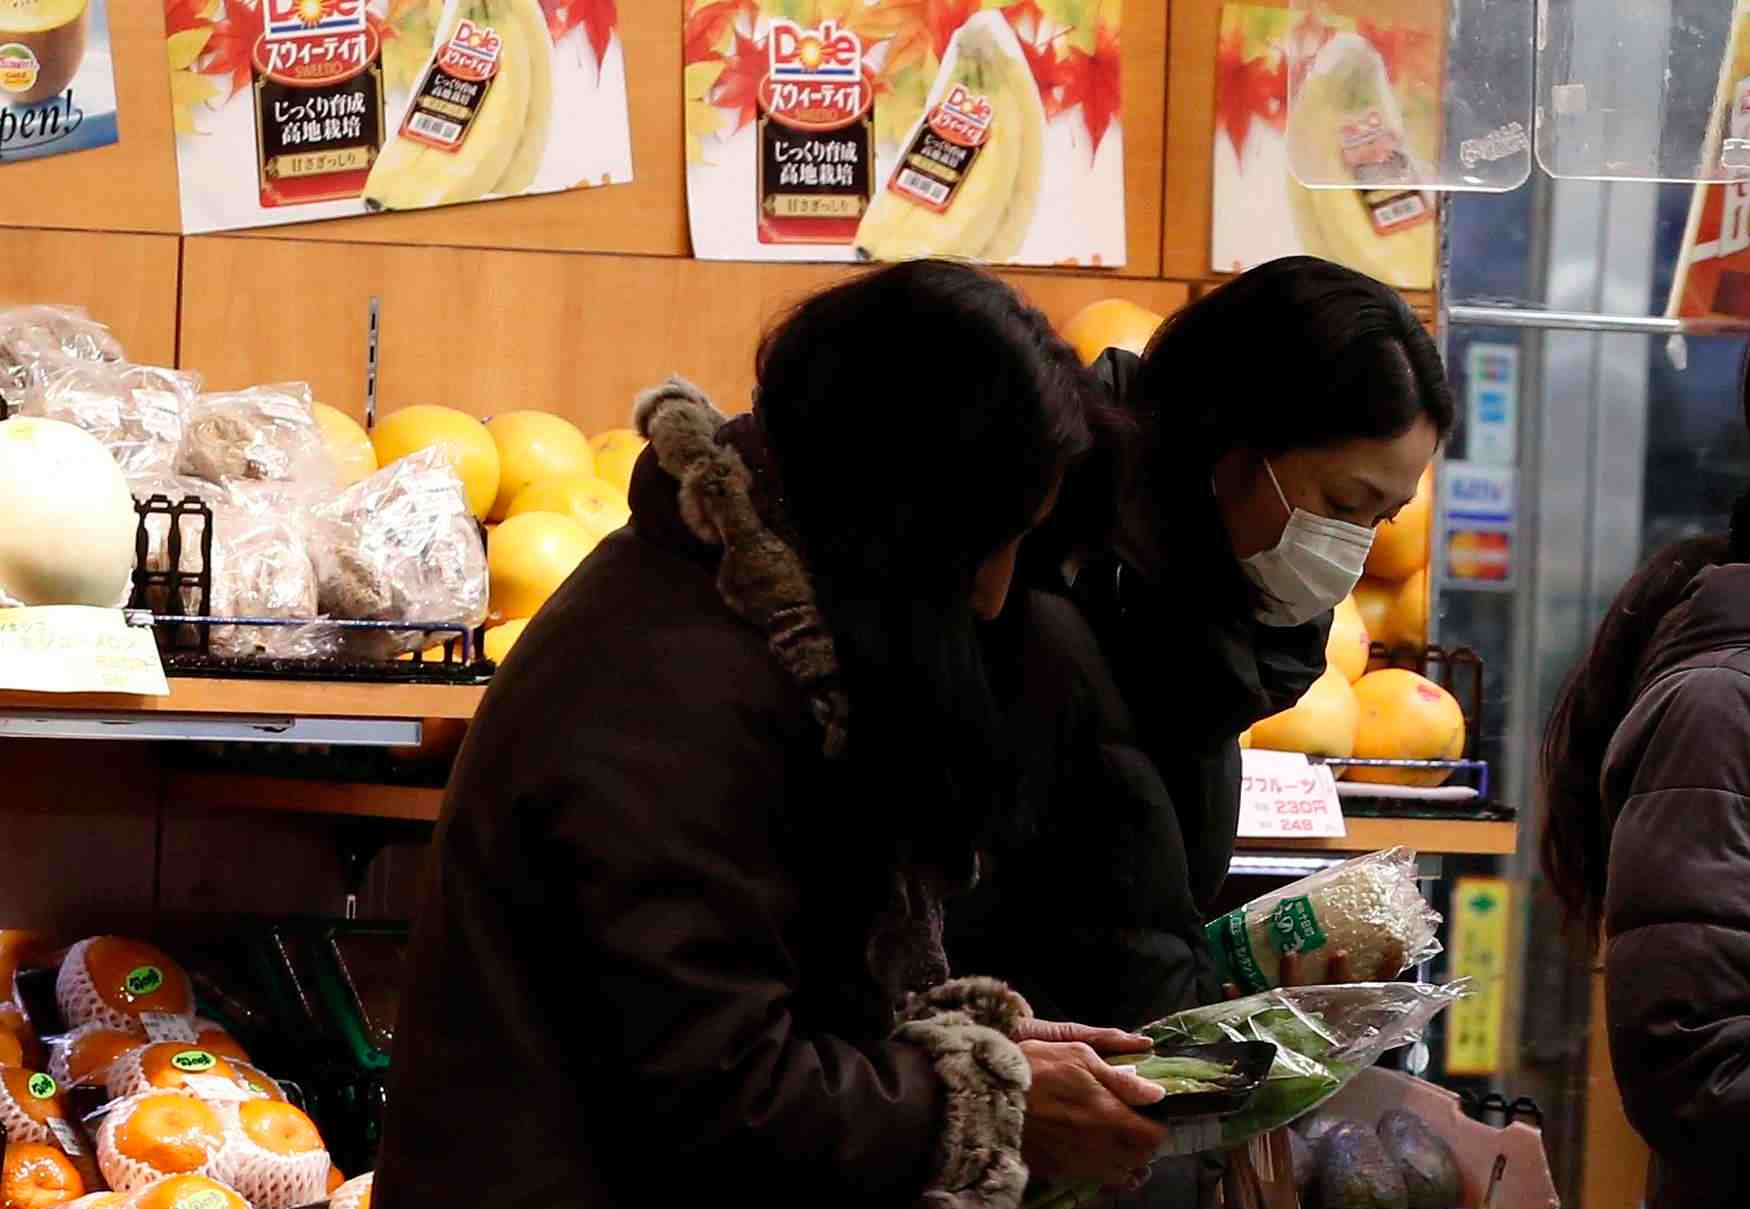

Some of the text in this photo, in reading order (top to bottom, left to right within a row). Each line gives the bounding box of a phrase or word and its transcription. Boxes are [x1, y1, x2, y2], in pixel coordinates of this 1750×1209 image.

[265, 33, 368, 74] スウィーティオ
[773, 23, 857, 67] Dole
[274, 91, 366, 123] じっくり育成
[769, 84, 862, 114] スウィーティオ
[281, 115, 361, 145] 高地栽培
